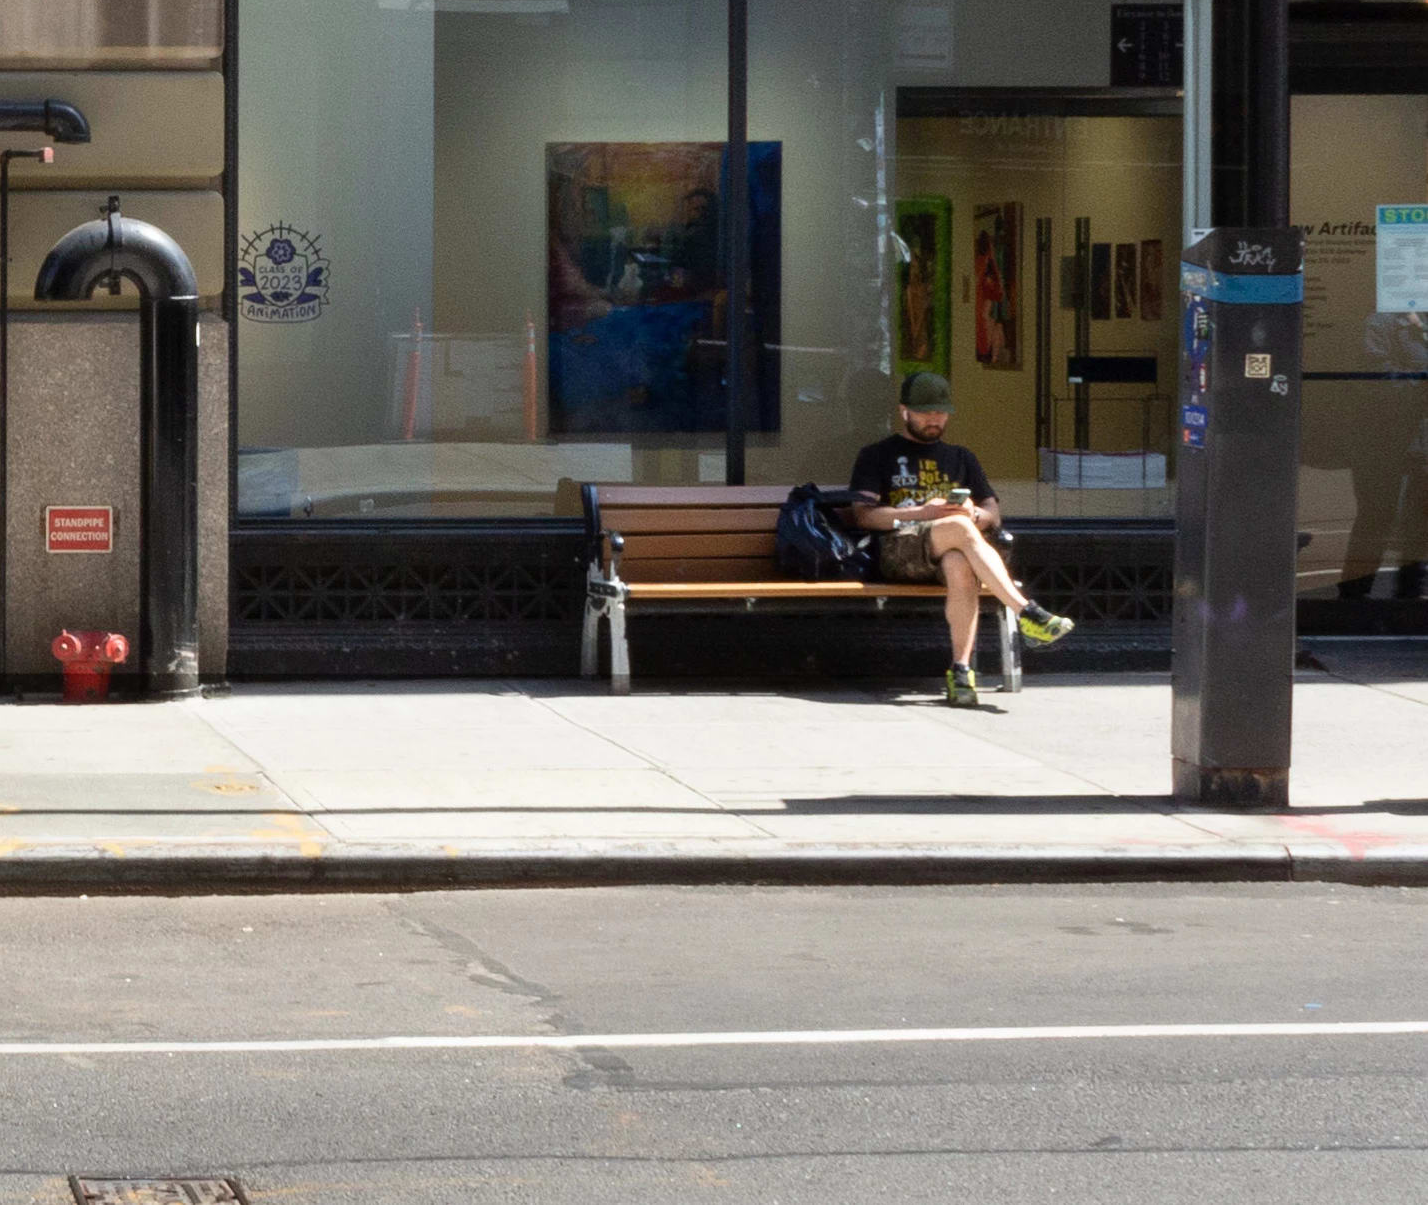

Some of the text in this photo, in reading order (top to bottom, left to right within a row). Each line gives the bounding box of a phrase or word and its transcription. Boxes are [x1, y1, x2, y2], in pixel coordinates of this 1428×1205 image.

[1384, 208, 1428, 223] STO
[258, 265, 303, 274] CLASS OF
[260, 275, 303, 291] 2023
[54, 517, 105, 528] STANDPIPE
[51, 531, 109, 541] CONNECTION
